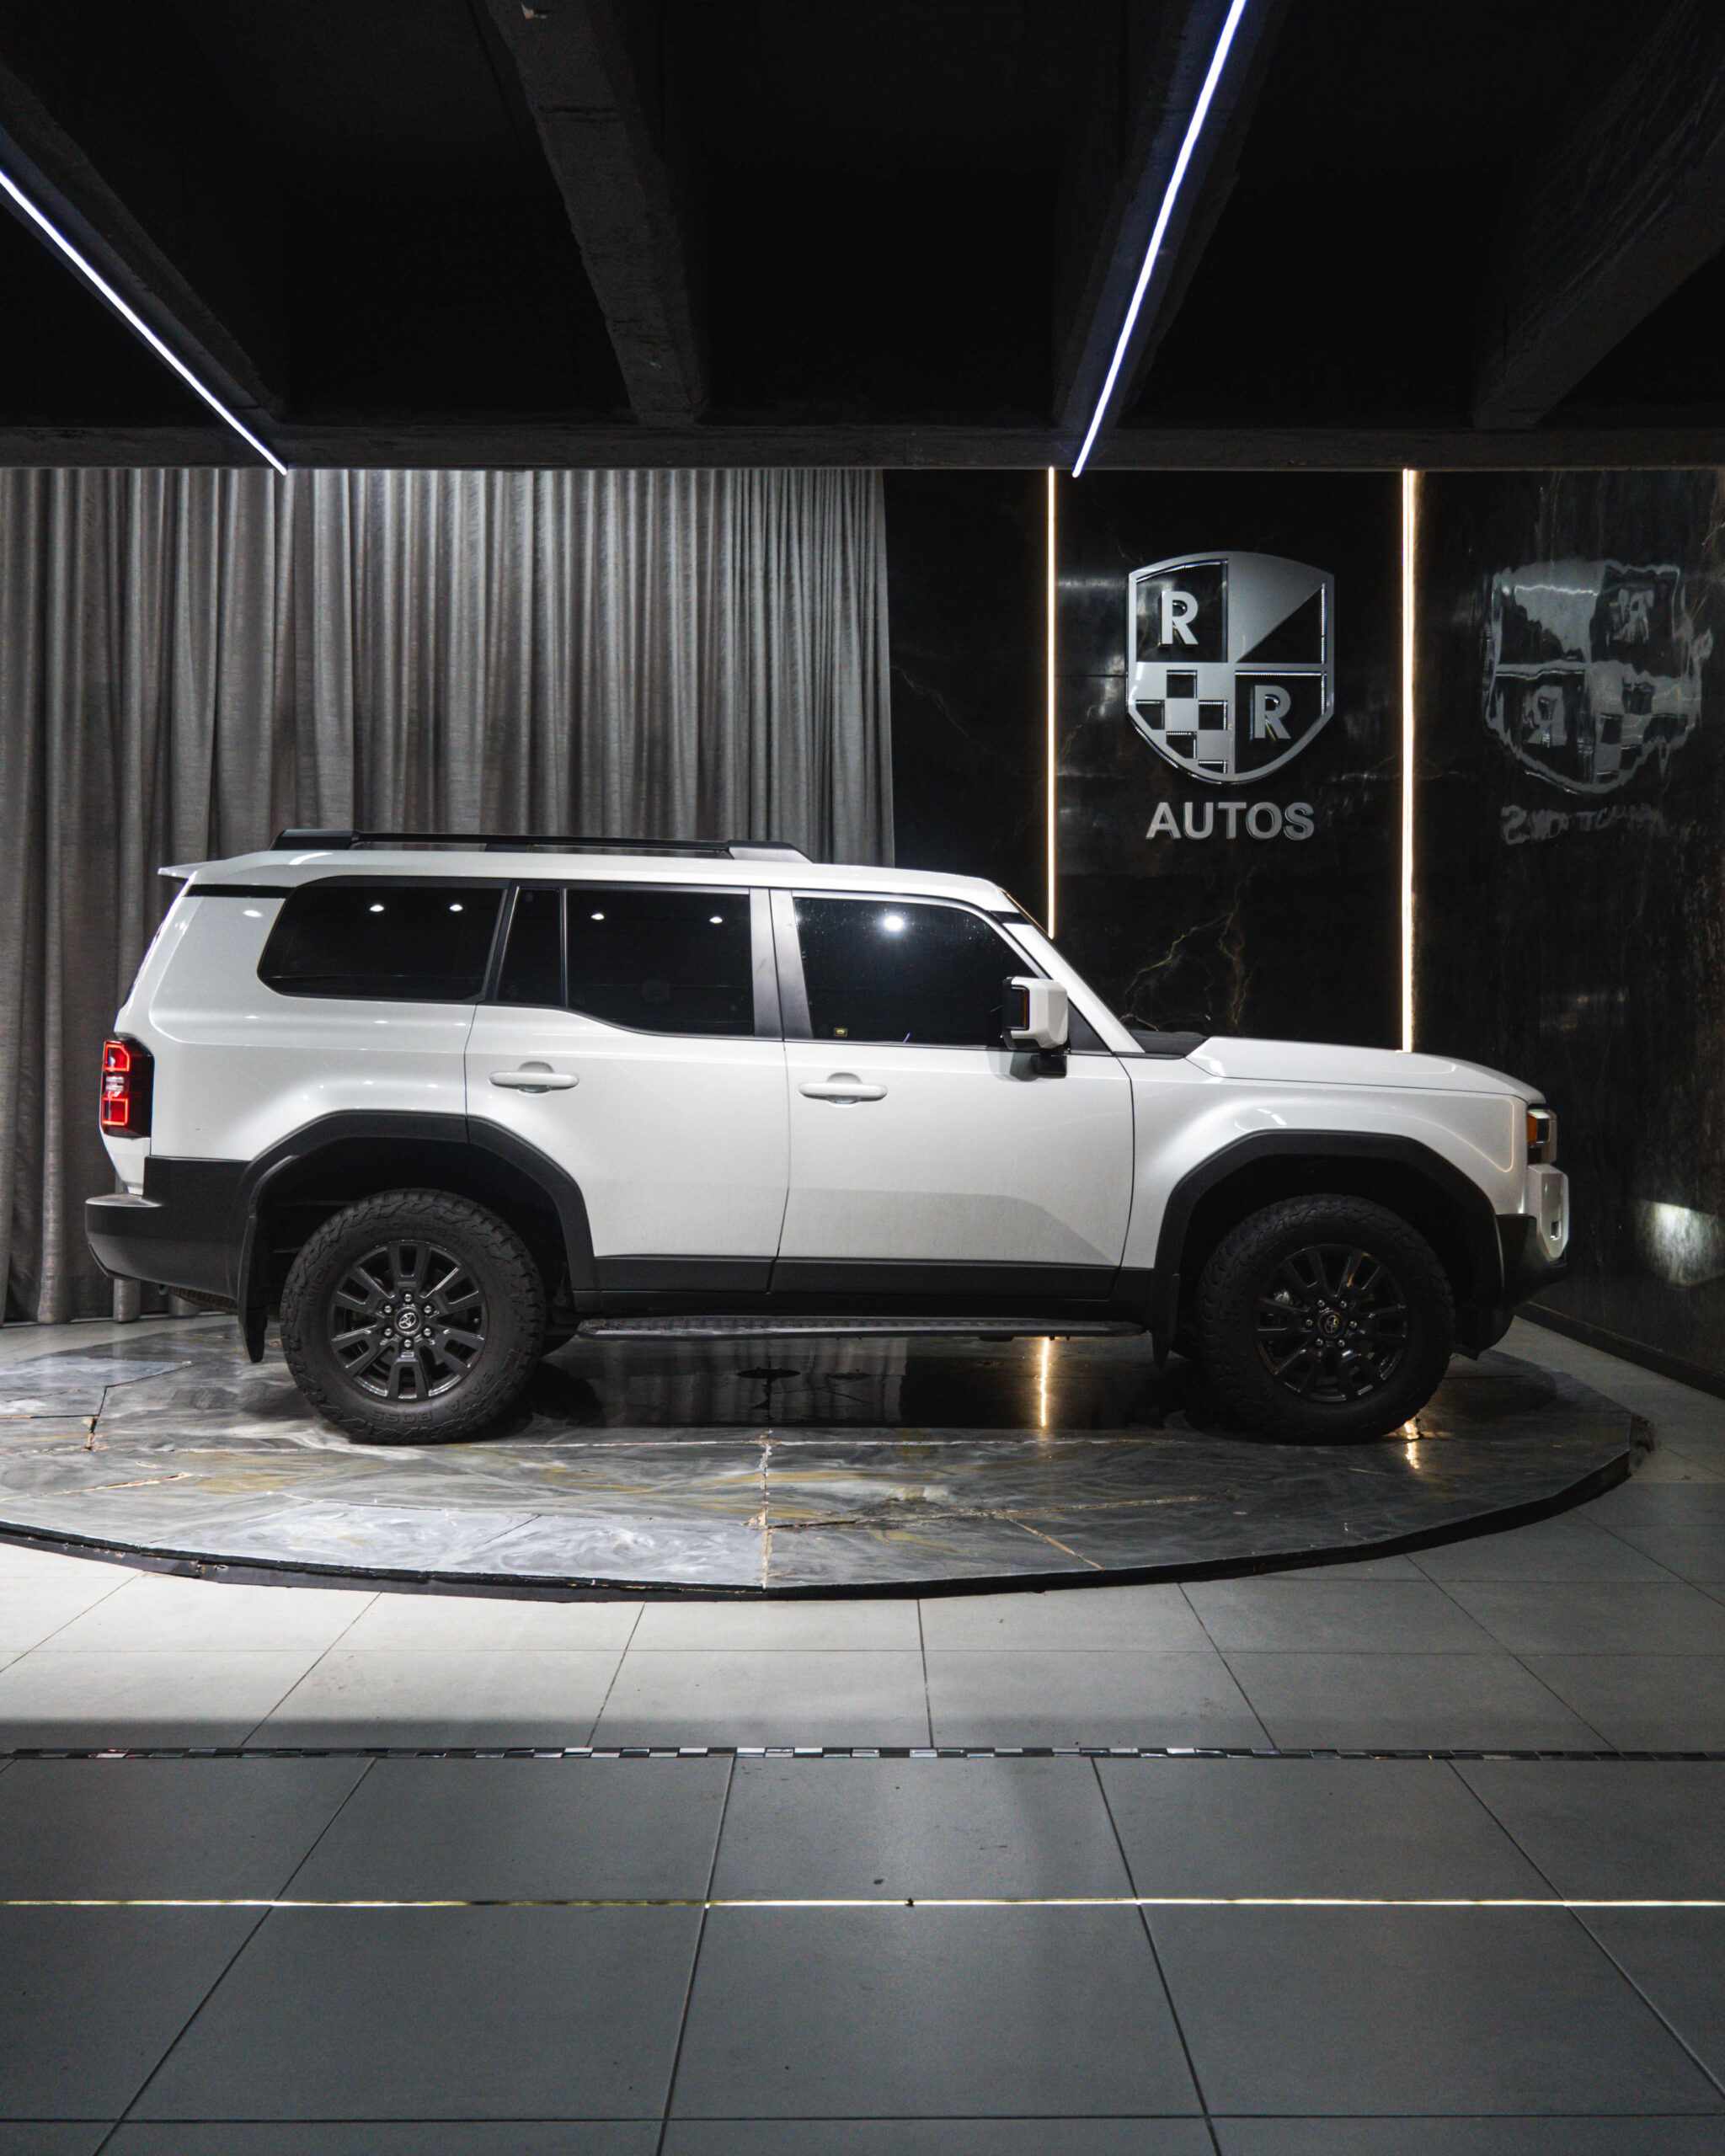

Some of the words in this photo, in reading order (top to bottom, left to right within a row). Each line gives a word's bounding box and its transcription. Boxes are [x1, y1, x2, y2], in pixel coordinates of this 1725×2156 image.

[1160, 590, 1199, 645] R
[1252, 685, 1291, 739] R
[1145, 802, 1315, 841] AUTOS
[370, 1407, 433, 1424] BOSS
